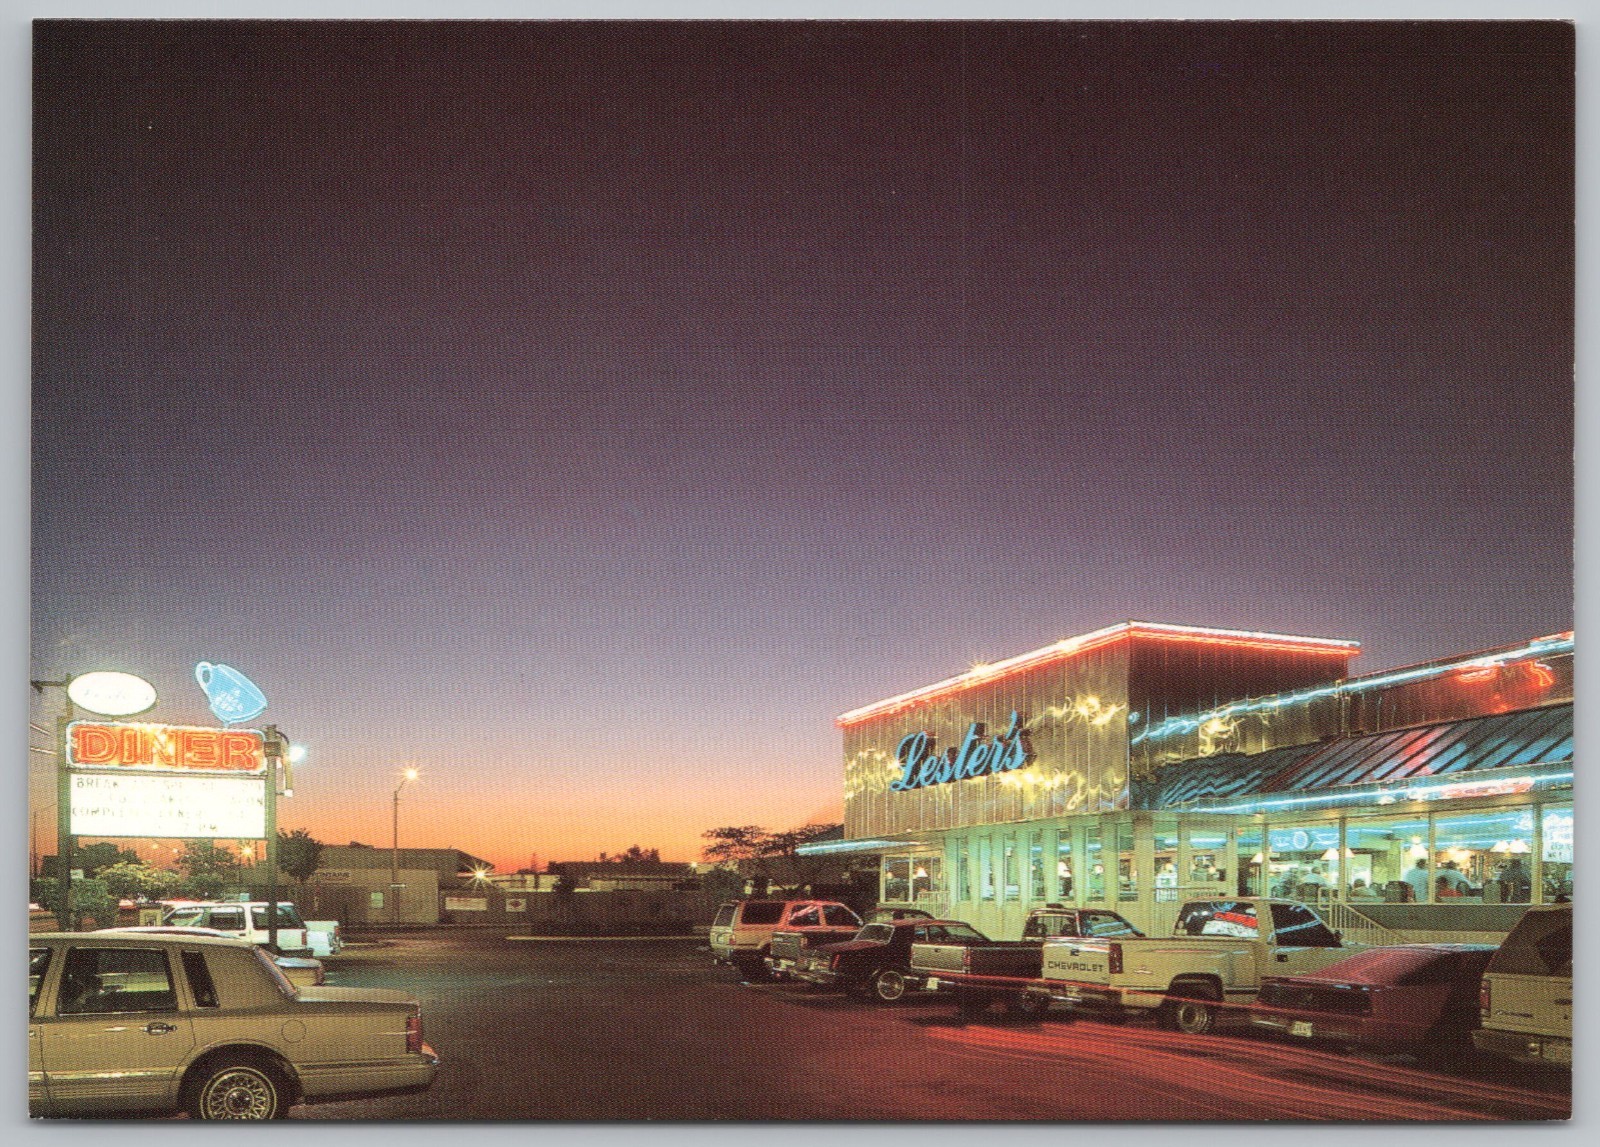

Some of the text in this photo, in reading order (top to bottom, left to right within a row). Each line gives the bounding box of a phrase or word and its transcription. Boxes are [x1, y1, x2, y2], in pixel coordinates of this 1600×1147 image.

[77, 724, 257, 769] DINER
[890, 710, 1029, 791] Lester's
[1047, 960, 1104, 972] CHEVROLET
